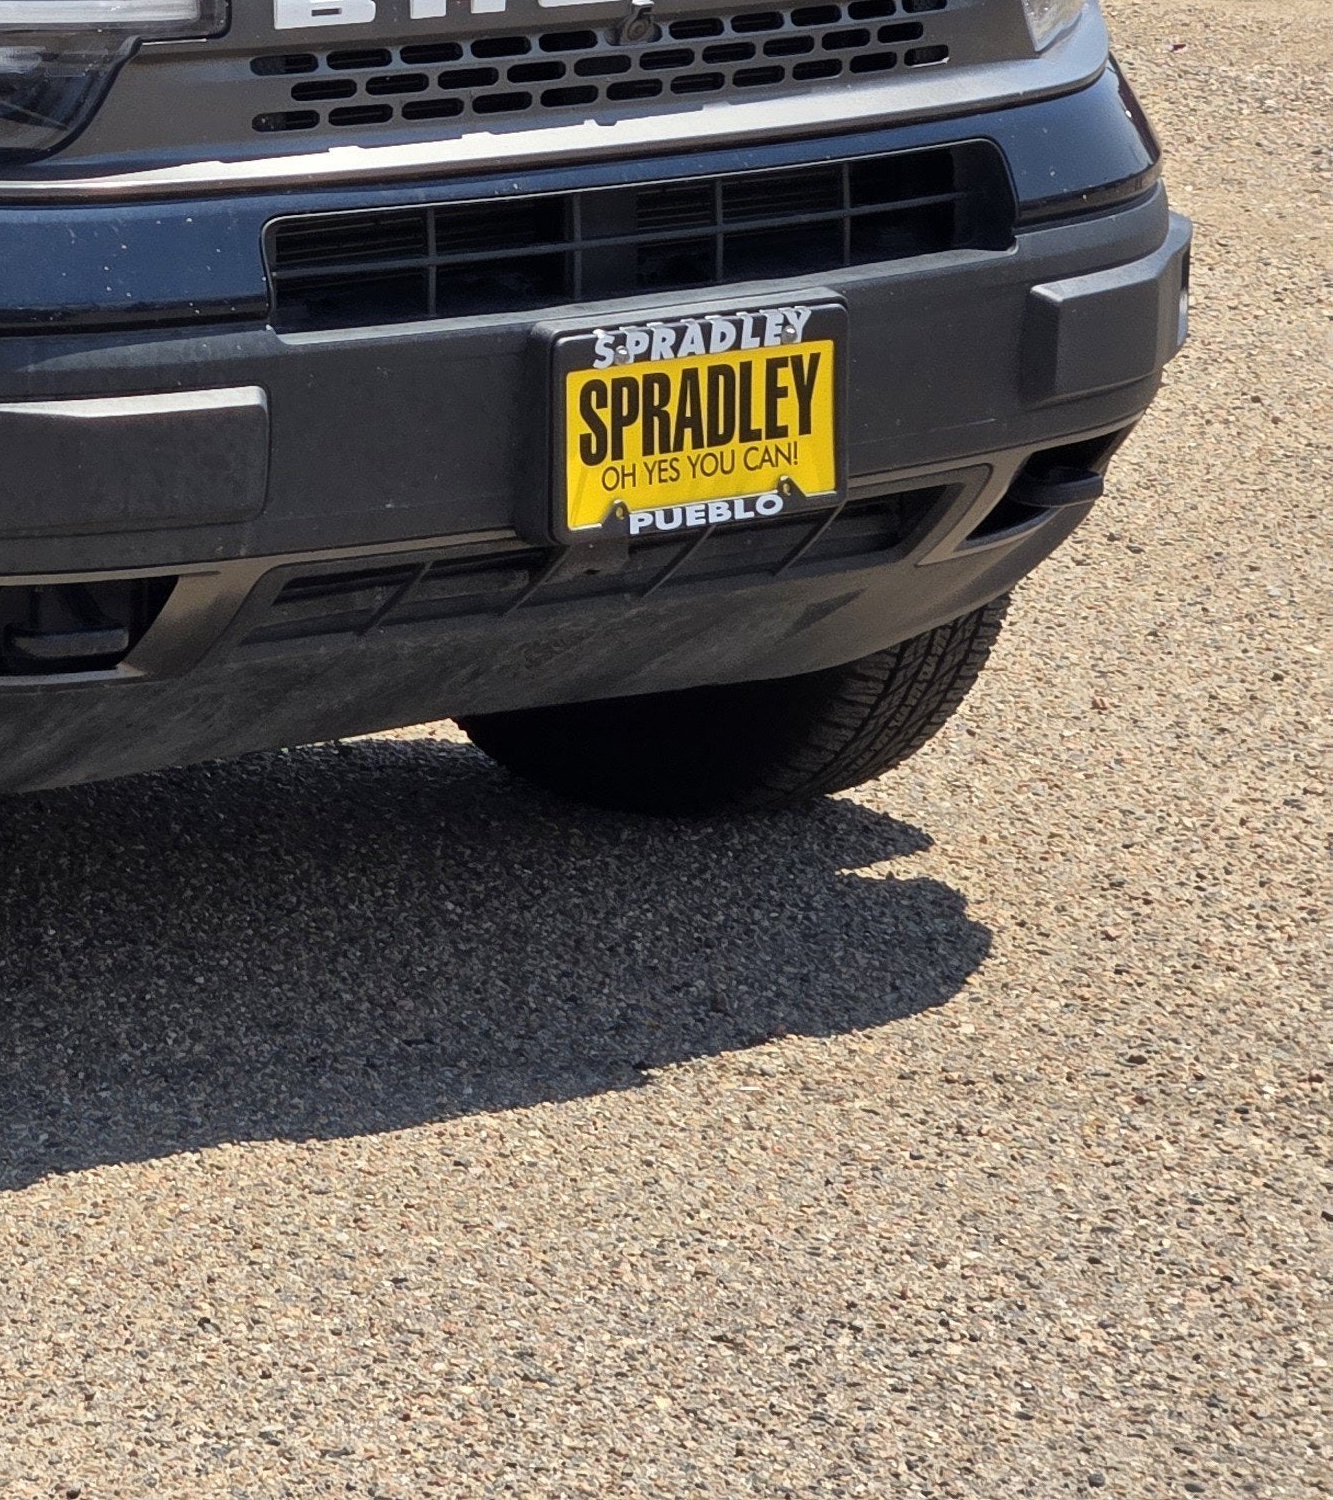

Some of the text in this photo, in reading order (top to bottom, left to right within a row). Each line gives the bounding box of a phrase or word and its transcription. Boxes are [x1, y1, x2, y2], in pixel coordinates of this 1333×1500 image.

[592, 305, 812, 369] SPRADLEY
[579, 352, 822, 467] SPRADLEY
[601, 441, 799, 492] OH YES YOU CAN!
[629, 493, 784, 535] PUEBLO
